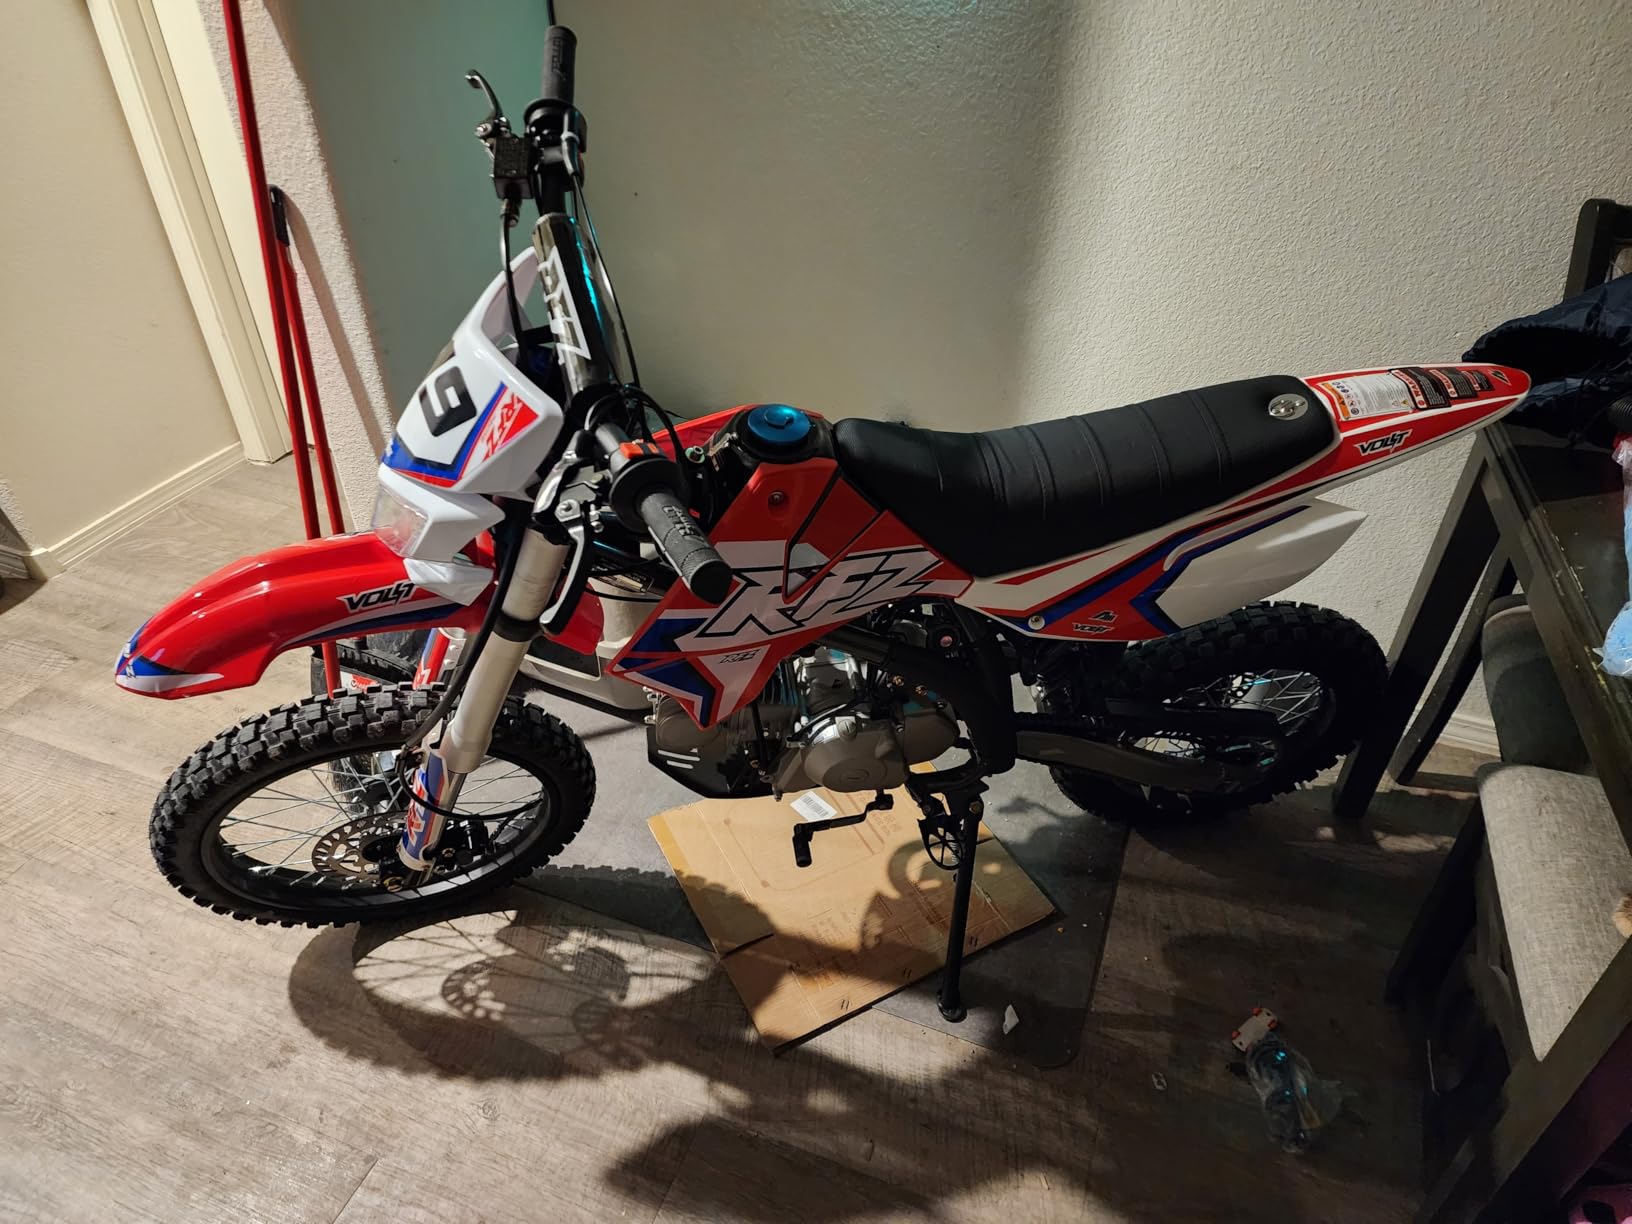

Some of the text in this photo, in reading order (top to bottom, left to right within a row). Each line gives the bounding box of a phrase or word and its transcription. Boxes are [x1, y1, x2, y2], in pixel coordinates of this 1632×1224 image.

[1358, 430, 1410, 454] VOLT
[344, 582, 416, 611] VOLT
[694, 547, 942, 638] RFZ
